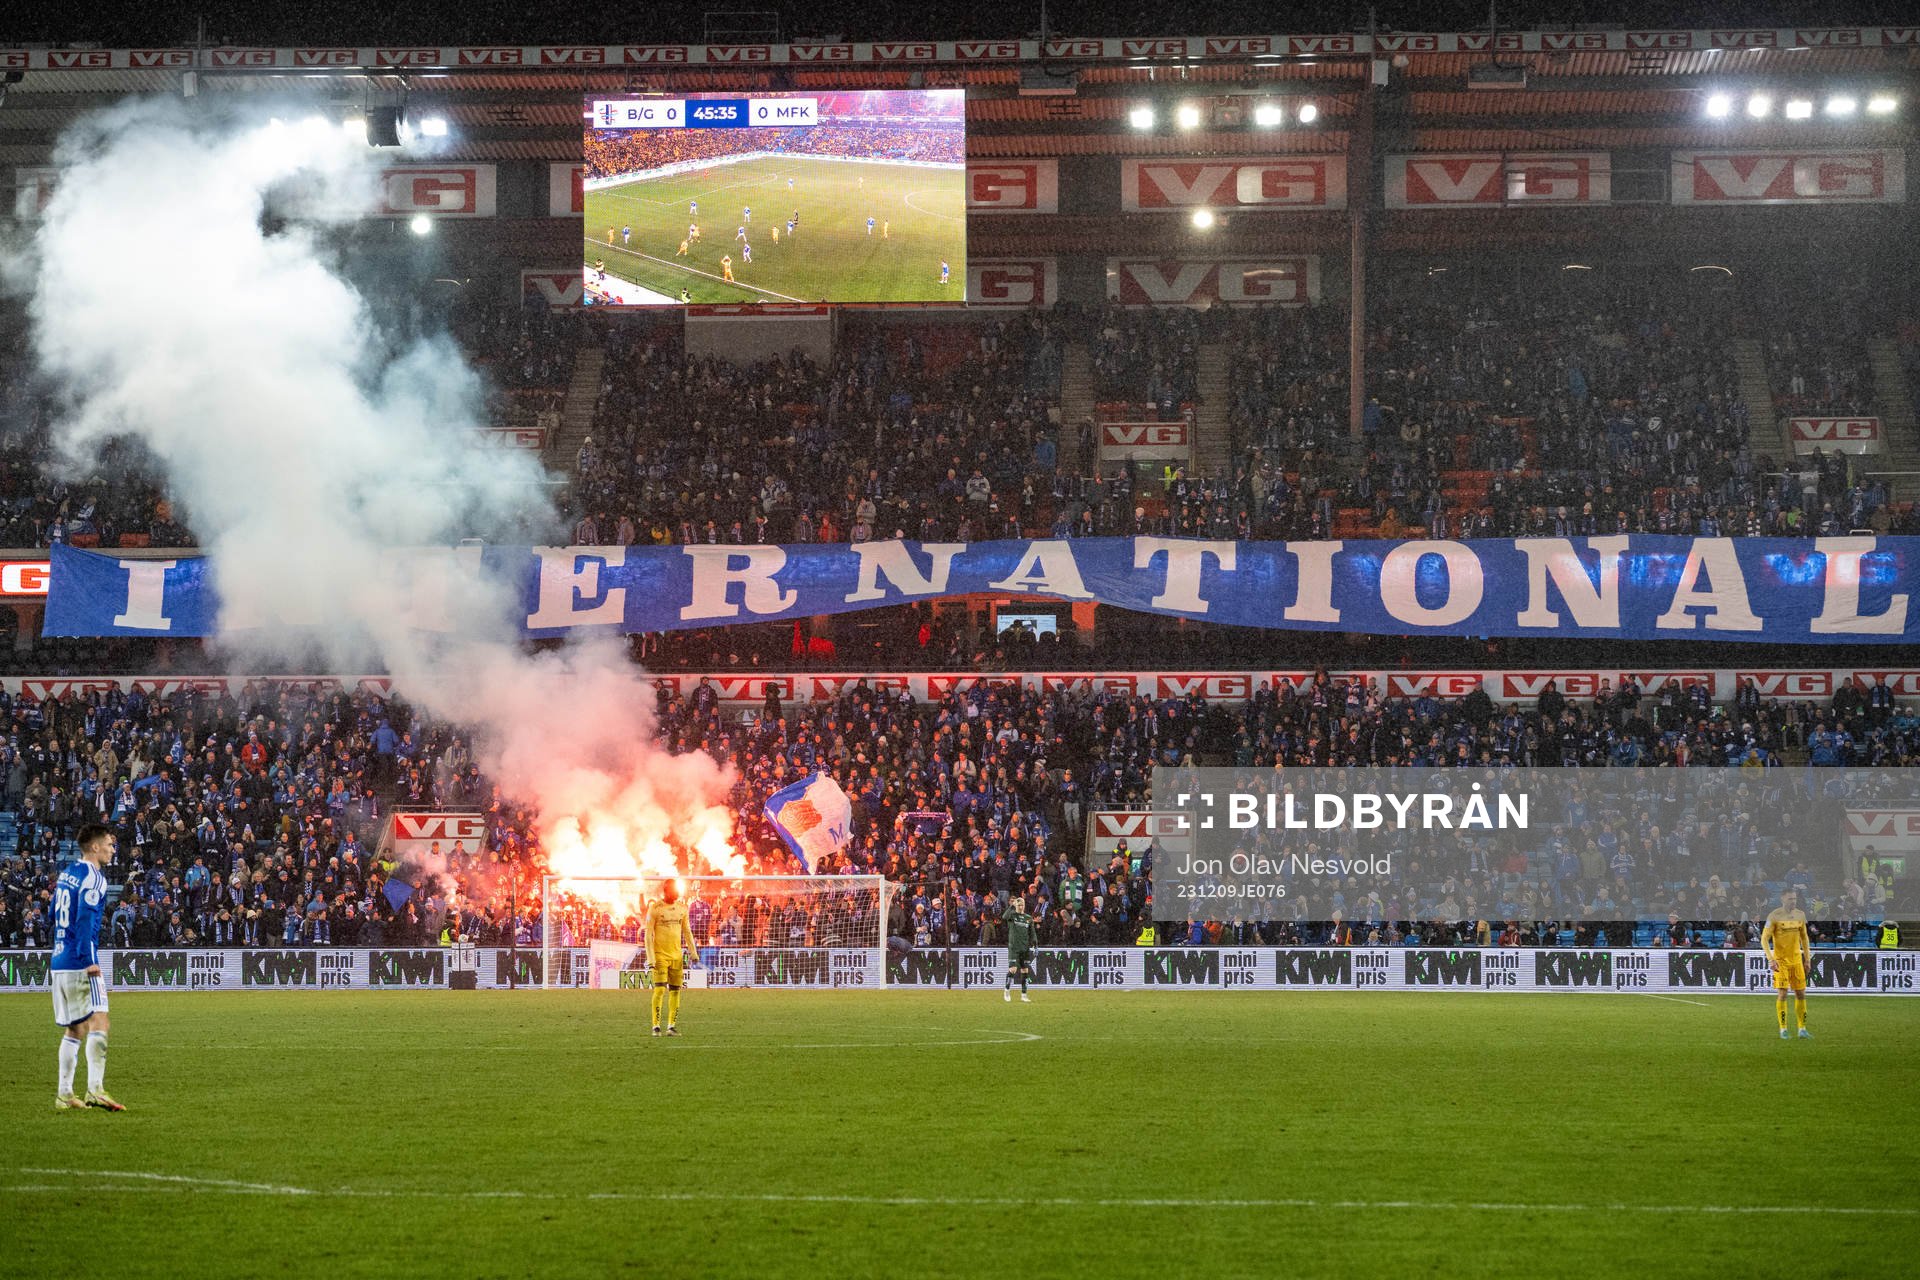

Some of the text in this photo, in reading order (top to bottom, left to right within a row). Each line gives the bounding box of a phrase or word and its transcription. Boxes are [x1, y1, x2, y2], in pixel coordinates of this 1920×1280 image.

[1208, 39, 1268, 53] VG
[1291, 38, 1351, 52] VG
[1375, 37, 1436, 51] VG
[1459, 36, 1521, 50] VG
[1542, 34, 1605, 48] VG
[1627, 34, 1690, 47] VG
[1712, 33, 1775, 46] VG
[1797, 32, 1859, 45] VG
[378, 50, 438, 64] VG
[461, 50, 521, 63] VG
[542, 49, 603, 63] VG
[625, 49, 686, 62] VG
[708, 48, 768, 62] VG
[791, 46, 851, 60] VG
[873, 45, 934, 59] VG
[956, 44, 1018, 58] VG
[1046, 42, 1102, 56] VG
[1123, 41, 1185, 55] VG
[0, 53, 25, 67] G
[50, 52, 110, 67] VG
[132, 52, 191, 66] VG
[214, 51, 274, 65] VG
[296, 50, 356, 65] VG
[627, 108, 654, 121] B/G
[693, 106, 737, 120] 45:35
[776, 106, 809, 118] MFK
[1143, 165, 1316, 205] VG
[1410, 161, 1579, 201] VG
[1699, 157, 1874, 197] VG
[388, 172, 466, 210] G
[967, 168, 1027, 207] G
[530, 277, 584, 304] V
[967, 267, 1034, 303] G
[1125, 263, 1296, 302] VG
[1107, 426, 1183, 444] VG
[1795, 420, 1872, 439] VG
[2, 563, 51, 593] G
[713, 680, 787, 698] VG
[1160, 677, 1246, 696] VG
[1392, 677, 1478, 696] VG
[1508, 677, 1596, 695] VG
[1740, 675, 1825, 693] VG
[396, 815, 487, 838] VG
[1097, 815, 1185, 837] VG
[1886, 933, 1895, 942] 35
[0, 952, 52, 985] IWI
[112, 952, 187, 985] KIWI
[191, 952, 224, 969] mini
[242, 952, 317, 985] KIWI
[320, 952, 353, 968] mini
[369, 951, 444, 985] KIWI
[754, 951, 829, 985] KIWI
[834, 952, 867, 968] mini
[886, 951, 960, 985] KIWI
[964, 951, 997, 968] mini
[1093, 951, 1127, 968] mini
[1144, 951, 1219, 985] KIWI
[1224, 951, 1257, 968] mini
[1276, 951, 1351, 985] KIWI
[1355, 952, 1389, 968] mini
[1405, 951, 1481, 985] KIWI
[1486, 952, 1519, 969] mini
[1535, 951, 1611, 986] KIWI
[1616, 953, 1650, 969] mini
[1882, 954, 1915, 970] mini
[1668, 952, 1745, 986] KIWI
[192, 969, 221, 989] pris
[320, 969, 351, 988] pris
[620, 970, 656, 990] KIW
[834, 969, 864, 989] pris
[964, 969, 994, 989] pris
[1093, 969, 1124, 989] pris
[1224, 969, 1254, 989] pris
[1355, 969, 1386, 989] pris
[1486, 970, 1516, 989] pris
[1616, 970, 1647, 990] pris
[1750, 970, 1771, 990] pri
[1882, 971, 1913, 991] pris
